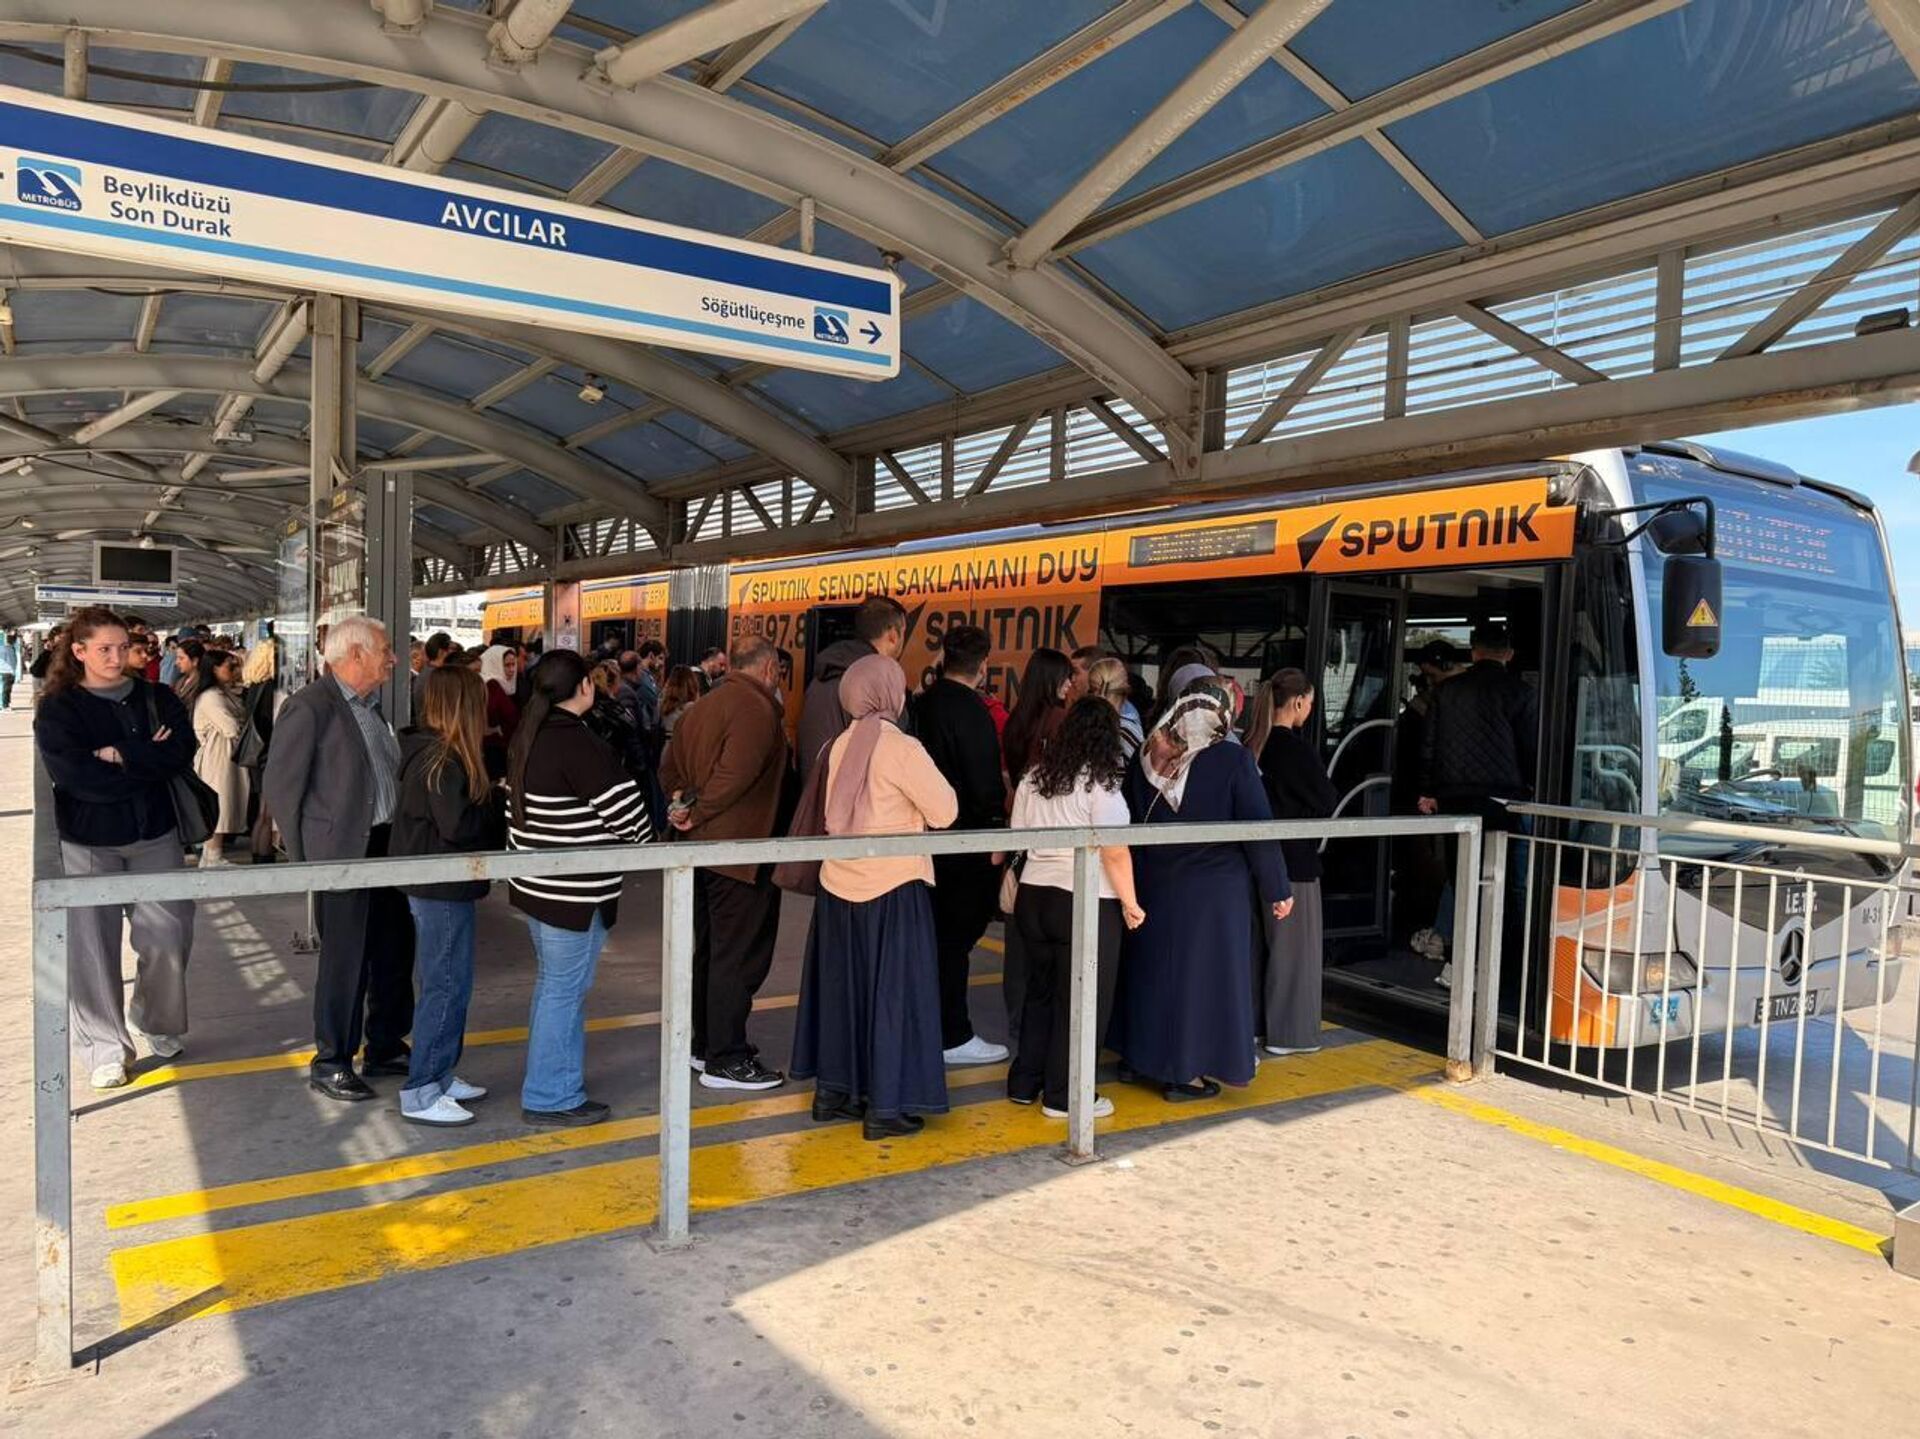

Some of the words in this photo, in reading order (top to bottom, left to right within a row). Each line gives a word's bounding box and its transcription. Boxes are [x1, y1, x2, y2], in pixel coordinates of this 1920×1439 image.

[103, 175, 231, 215] Beylikdüzü
[110, 200, 155, 224] Son
[163, 209, 232, 237] Durak
[441, 201, 567, 247] AVCILAR
[701, 296, 806, 329] Söğütlüçeşme
[1339, 502, 1542, 557] SPUTNIK
[752, 577, 811, 603] SPUTNIK
[818, 570, 891, 602] SENDEN
[896, 556, 1027, 596] SAKLANANI
[765, 612, 806, 650] 97.8
